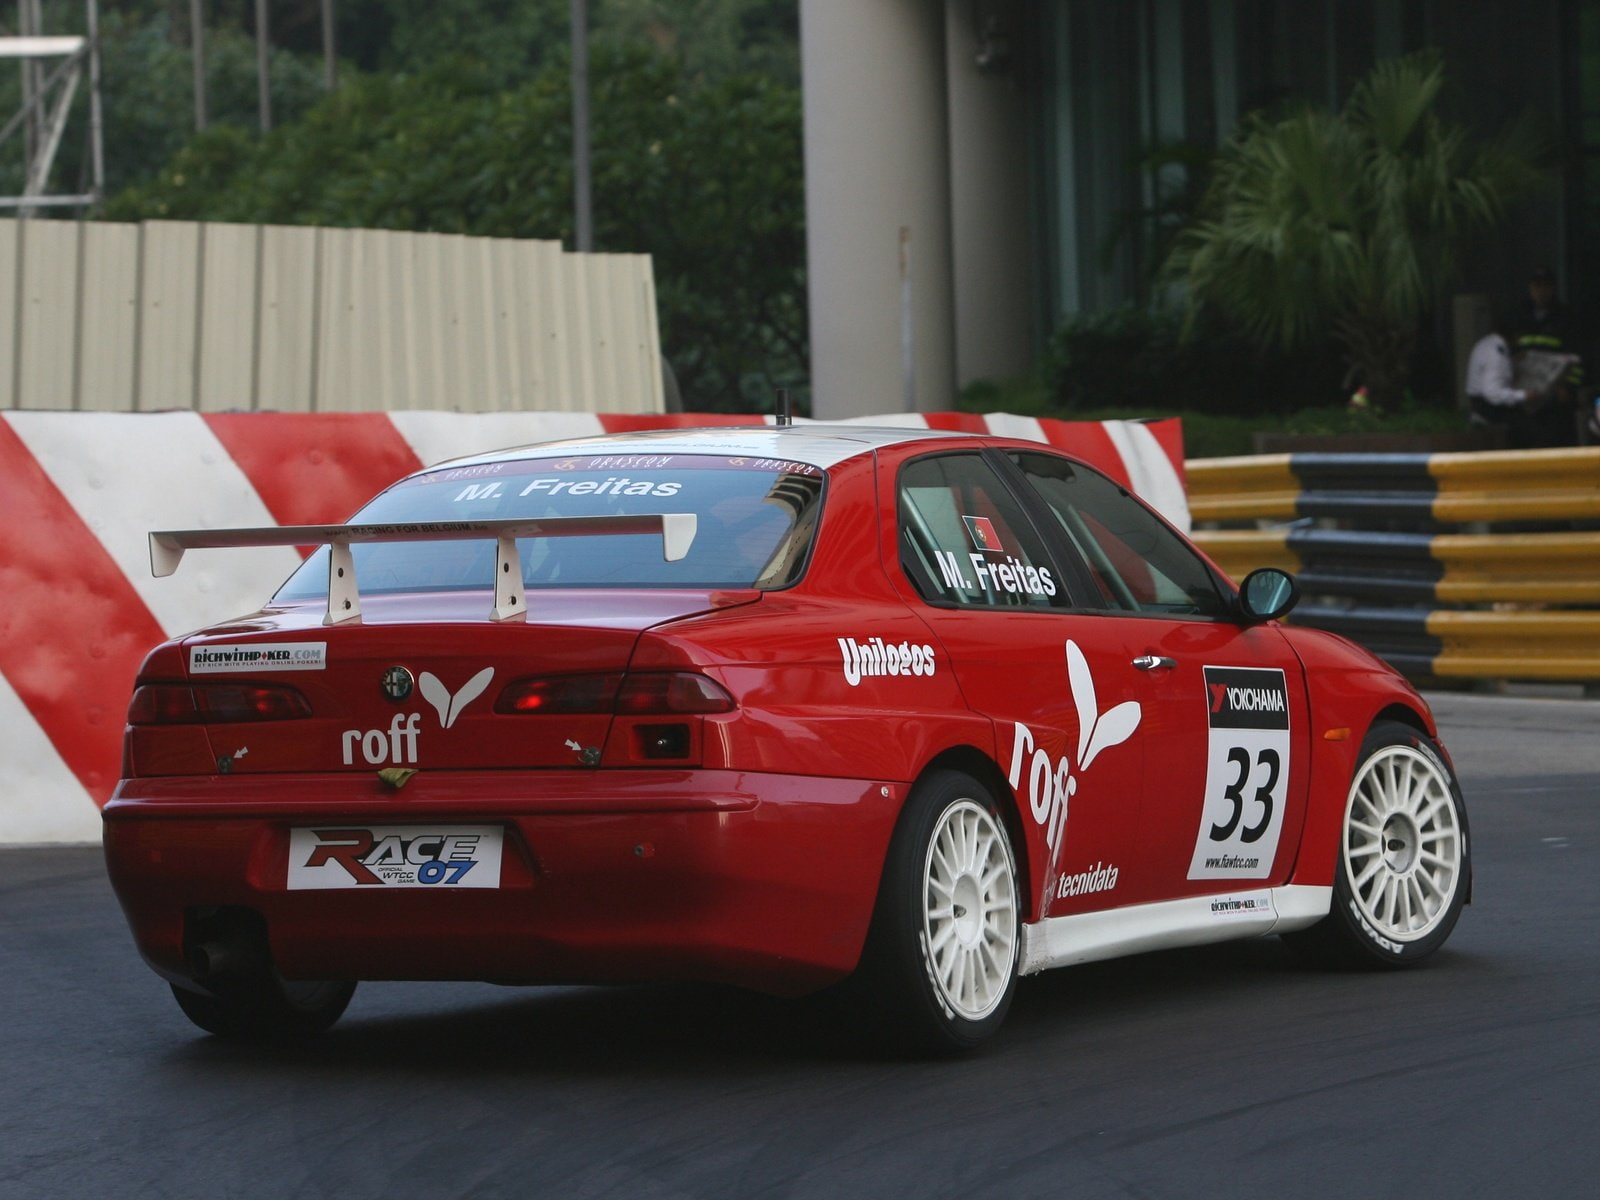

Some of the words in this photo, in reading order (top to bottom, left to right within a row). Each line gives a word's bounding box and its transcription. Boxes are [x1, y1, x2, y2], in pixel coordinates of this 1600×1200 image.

[589, 456, 673, 467] ORASCOM
[453, 482, 504, 502] M.
[519, 477, 682, 497] Freitas
[395, 525, 419, 534] FOR
[421, 524, 471, 533] BELGIUM
[934, 550, 972, 589] M.
[969, 553, 1056, 596] Freitas
[837, 637, 936, 687] Unilogos
[1226, 687, 1285, 712] YOKOHAMA
[342, 713, 421, 765] roff
[1009, 721, 1077, 868] roff
[1209, 746, 1281, 844] 33
[303, 829, 481, 885] RACE
[417, 860, 480, 885] 07
[1205, 854, 1259, 869] www.fiawtcc.com
[1057, 861, 1119, 899] tecnidata
